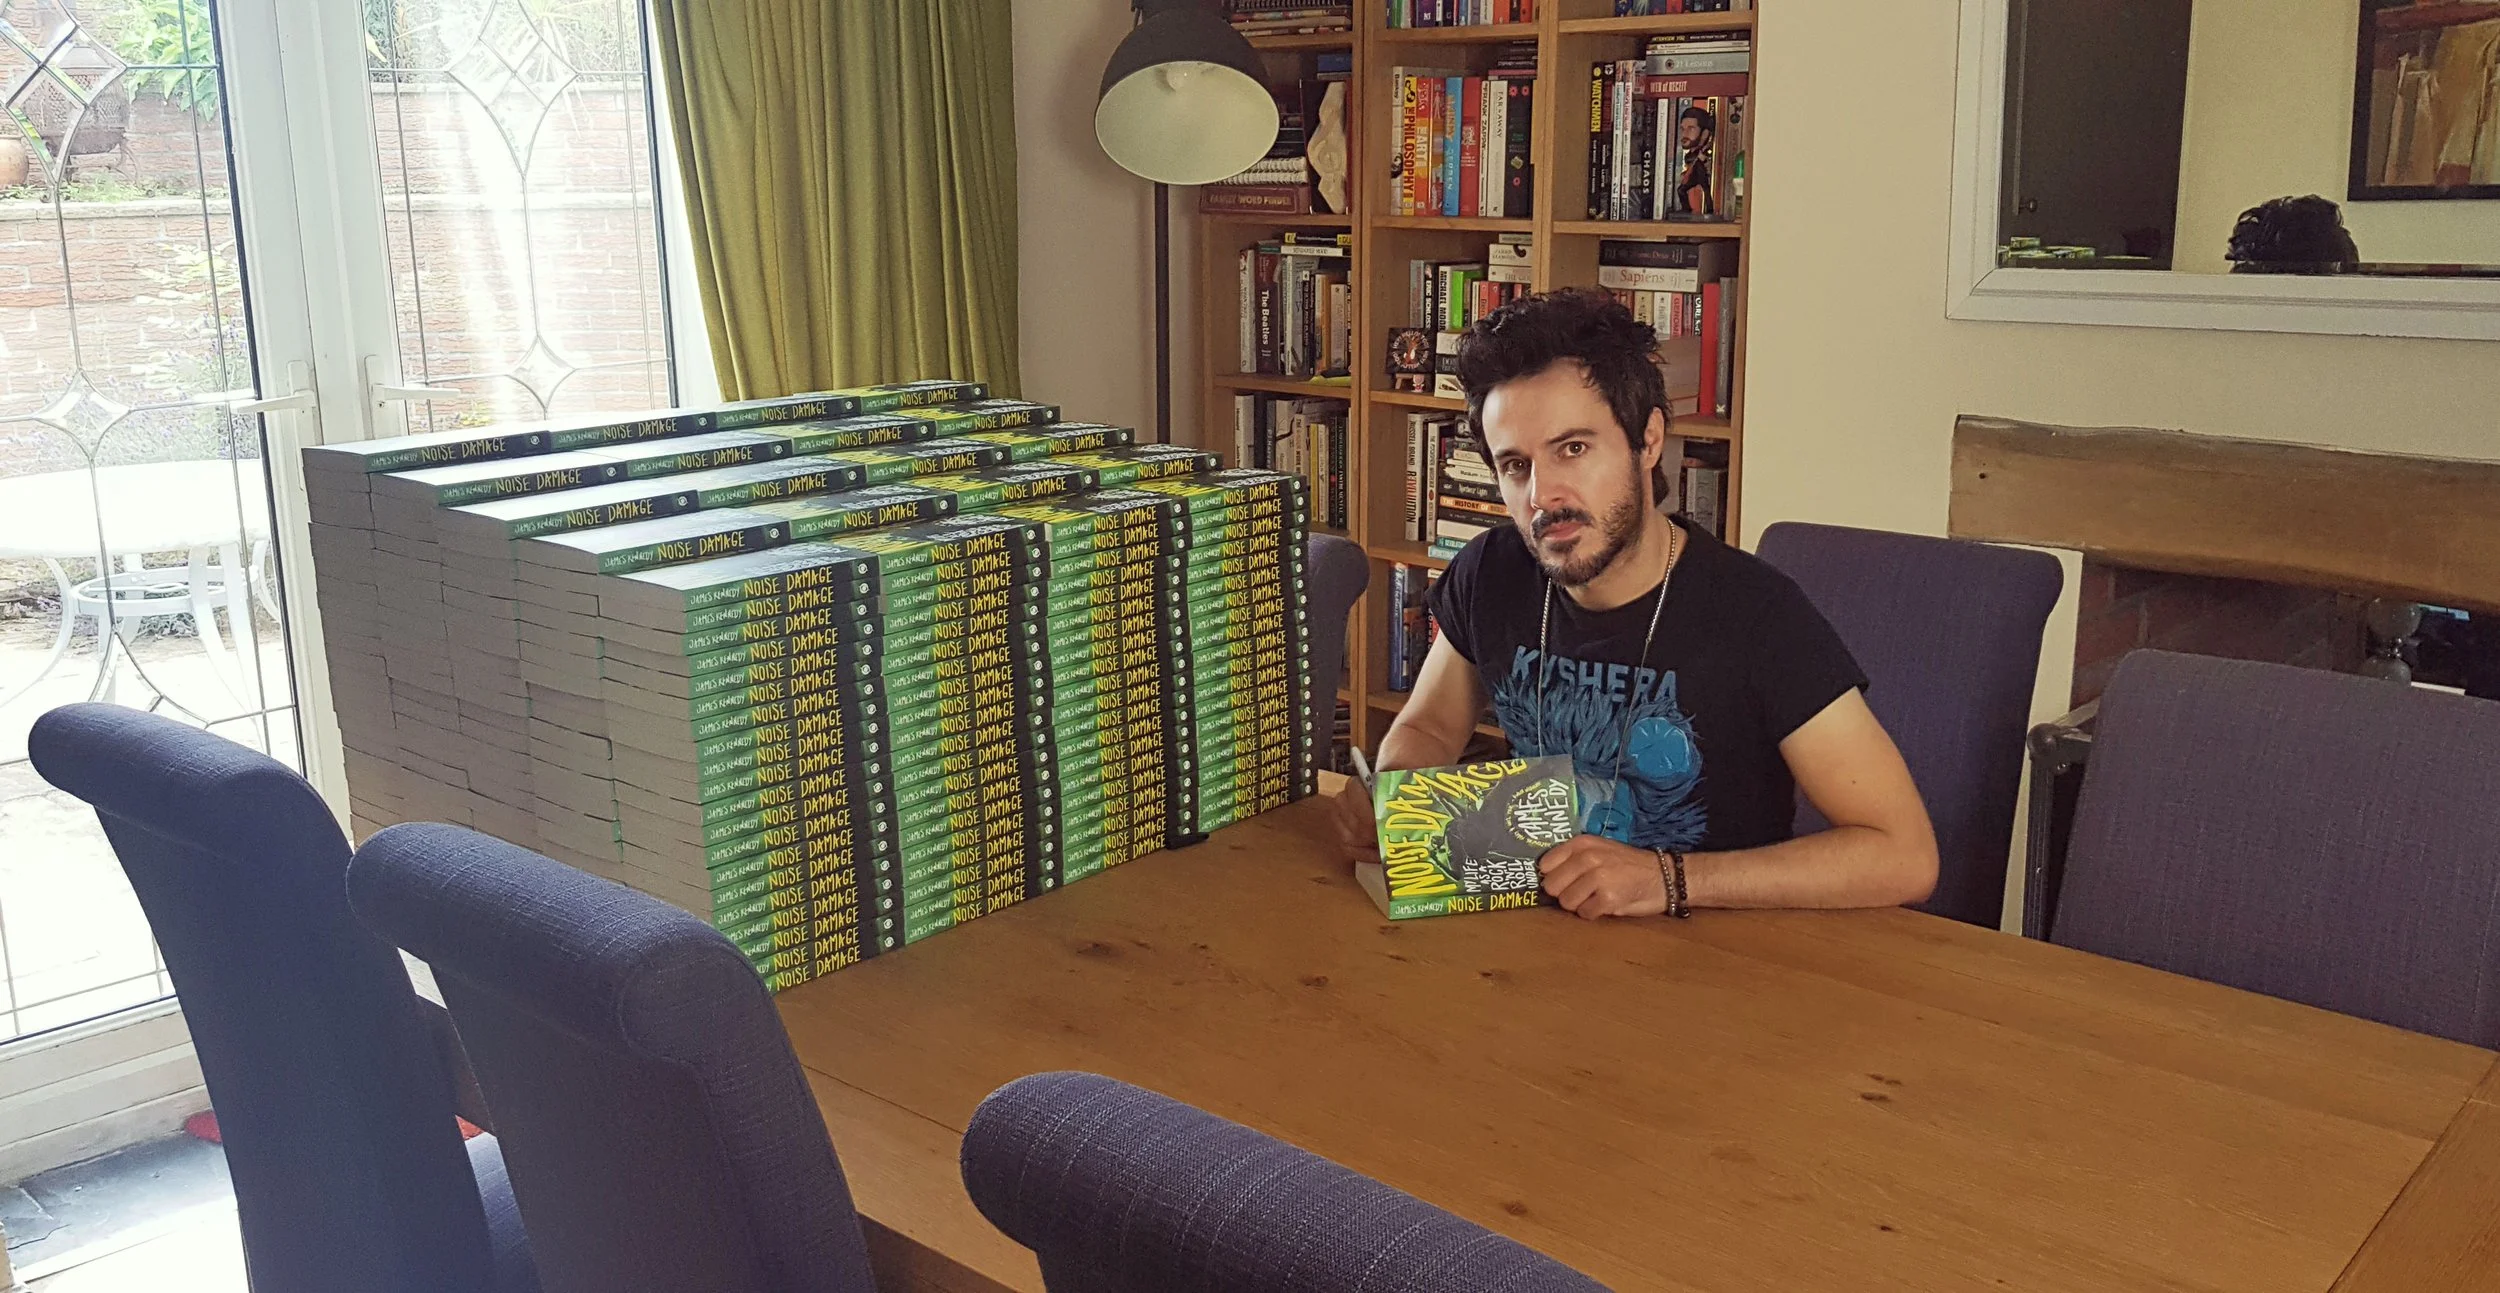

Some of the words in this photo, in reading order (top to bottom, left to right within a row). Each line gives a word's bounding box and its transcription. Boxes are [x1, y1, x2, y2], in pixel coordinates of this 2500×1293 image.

[1590, 79, 1602, 132] WATCHMEN
[1404, 116, 1415, 190] PHILOSOPHY
[1642, 151, 1650, 194] CHAOS
[1620, 269, 1664, 285] Sapiens
[1262, 309, 1270, 345] Beatles
[901, 393, 924, 406] NOISE
[928, 388, 957, 404] DAMAGE
[762, 408, 788, 420] NOISE
[793, 402, 826, 418] DAMAGE
[975, 416, 997, 430] NOISE
[1001, 411, 1030, 427] DAMAGE
[604, 424, 632, 440] NOISE
[638, 418, 677, 435] DAMAGE
[838, 432, 864, 447] NOISE
[868, 427, 902, 443] DAMAGE
[1050, 438, 1072, 452] NOISE
[1076, 433, 1105, 450] DAMAGE
[421, 446, 456, 462] NOISE
[462, 438, 506, 457] DAMAGE
[678, 453, 708, 469] NOISE
[714, 446, 753, 465] DAMAGE
[912, 459, 938, 474] NOISE
[943, 453, 976, 471] DAMAGE
[1138, 463, 1160, 478] NOISE
[1164, 458, 1193, 474] DAMAGE
[495, 476, 530, 495] NOISE
[537, 469, 582, 489] DAMAGE
[752, 481, 782, 499] NOISE
[788, 473, 827, 493] DAMAGE
[1001, 484, 1028, 500] NOISE
[1032, 476, 1066, 496] DAMAGE
[566, 508, 601, 528] NOISE
[608, 499, 653, 522] DAMAGE
[843, 510, 874, 528] NOISE
[879, 502, 918, 524] DAMAGE
[1094, 512, 1119, 532] NOISE
[1124, 503, 1156, 527] DAMAGE
[1455, 500, 1479, 509] HISTORY
[657, 541, 693, 561] NOISE
[699, 531, 744, 554] DAMAGE
[931, 542, 961, 563] NOISE
[967, 533, 1005, 556] DAMAGE
[1223, 542, 1245, 560] NOISE
[1250, 533, 1279, 554] DAMAGE
[744, 577, 780, 598] NOISE
[787, 566, 832, 592] DAMAGE
[1511, 645, 1676, 704] KYSHERA
[752, 705, 786, 725] NOISE
[794, 690, 840, 716] DAMAGE
[1234, 803, 1257, 821] NOISE
[1261, 790, 1290, 812] DAMAGE
[1384, 758, 1528, 831] DAMAGE
[1514, 789, 1552, 840] JAMES
[1544, 778, 1572, 842] ENNEDY
[1384, 834, 1457, 897] NOISE
[1463, 858, 1479, 880] LIFE
[1479, 874, 1492, 884] AS
[1486, 859, 1510, 890] ROCK
[1507, 860, 1526, 889] ROLL
[1524, 860, 1539, 888] UNDER
[1464, 880, 1481, 892] MY
[954, 903, 983, 925] NOISE
[988, 884, 1026, 913] DAMAGE
[1396, 905, 1416, 914] JAMES
[1418, 903, 1444, 913] KENNEDY
[1448, 895, 1484, 913] NOISE
[1490, 891, 1538, 910] DAMAGE
